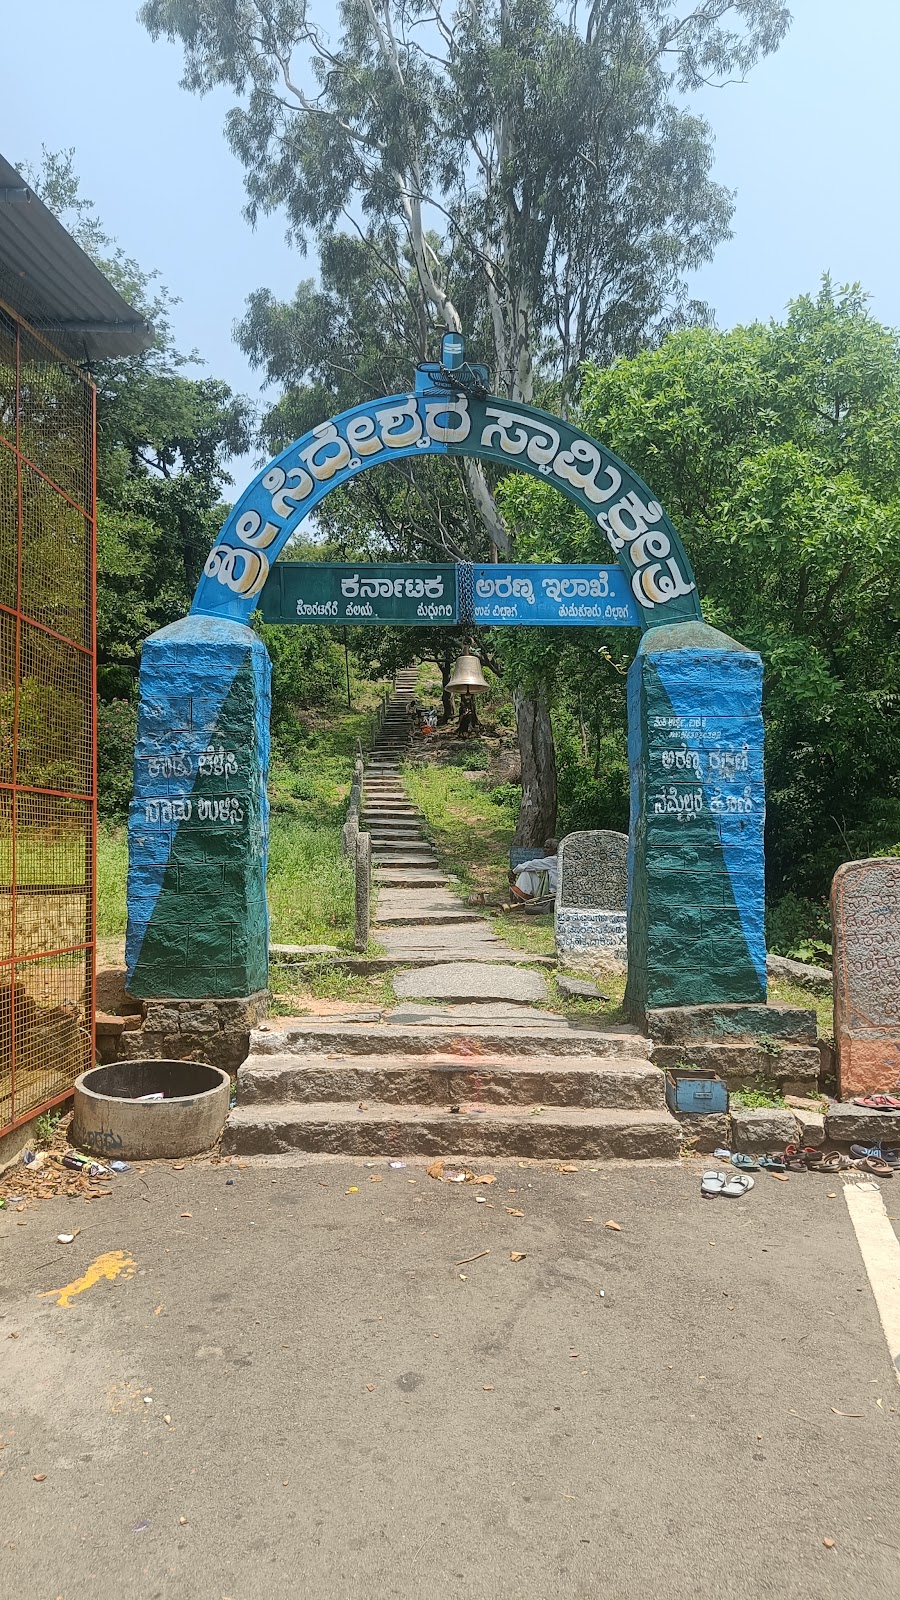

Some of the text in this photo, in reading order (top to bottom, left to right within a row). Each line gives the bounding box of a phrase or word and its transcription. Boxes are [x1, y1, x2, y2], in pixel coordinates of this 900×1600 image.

[204, 510, 281, 599] ಶ್ರೀ
[481, 406, 622, 504] ಸ್ವಾಮಿ
[596, 490, 696, 608] ಕ್ಷೇತ್ರ
[340, 574, 444, 599] ಕರ್ನಾಟಕ
[475, 575, 536, 605] ಅರಣ್ಯ
[474, 604, 490, 616] ಉಪ
[661, 742, 704, 779] ಅರಣ್ಯ
